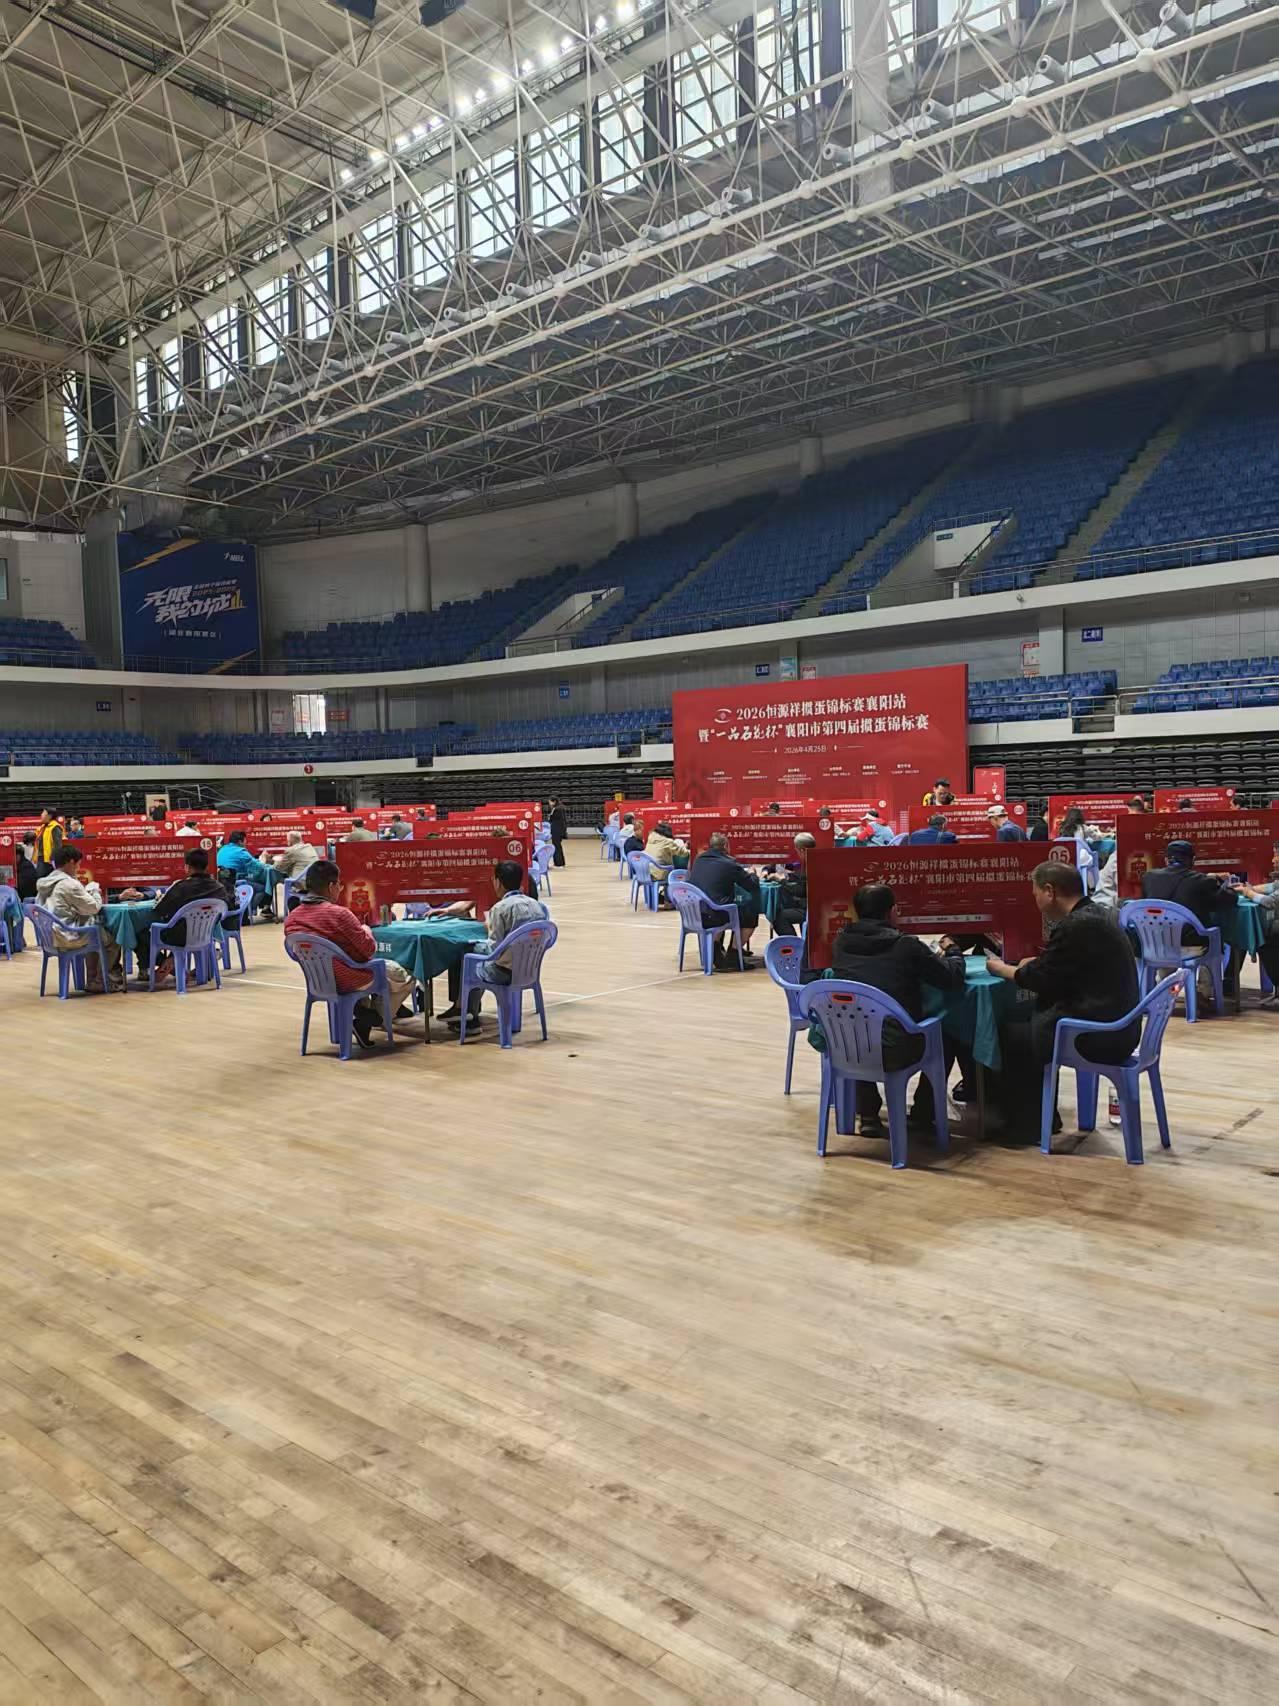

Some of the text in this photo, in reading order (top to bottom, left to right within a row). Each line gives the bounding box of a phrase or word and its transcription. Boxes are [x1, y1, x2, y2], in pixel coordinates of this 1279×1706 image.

[136, 585, 193, 614] 无限
[736, 693, 907, 720] 2026恒源祥掼蛋锦标赛襄阳站
[509, 843, 521, 853] 06
[1051, 849, 1068, 862] 05
